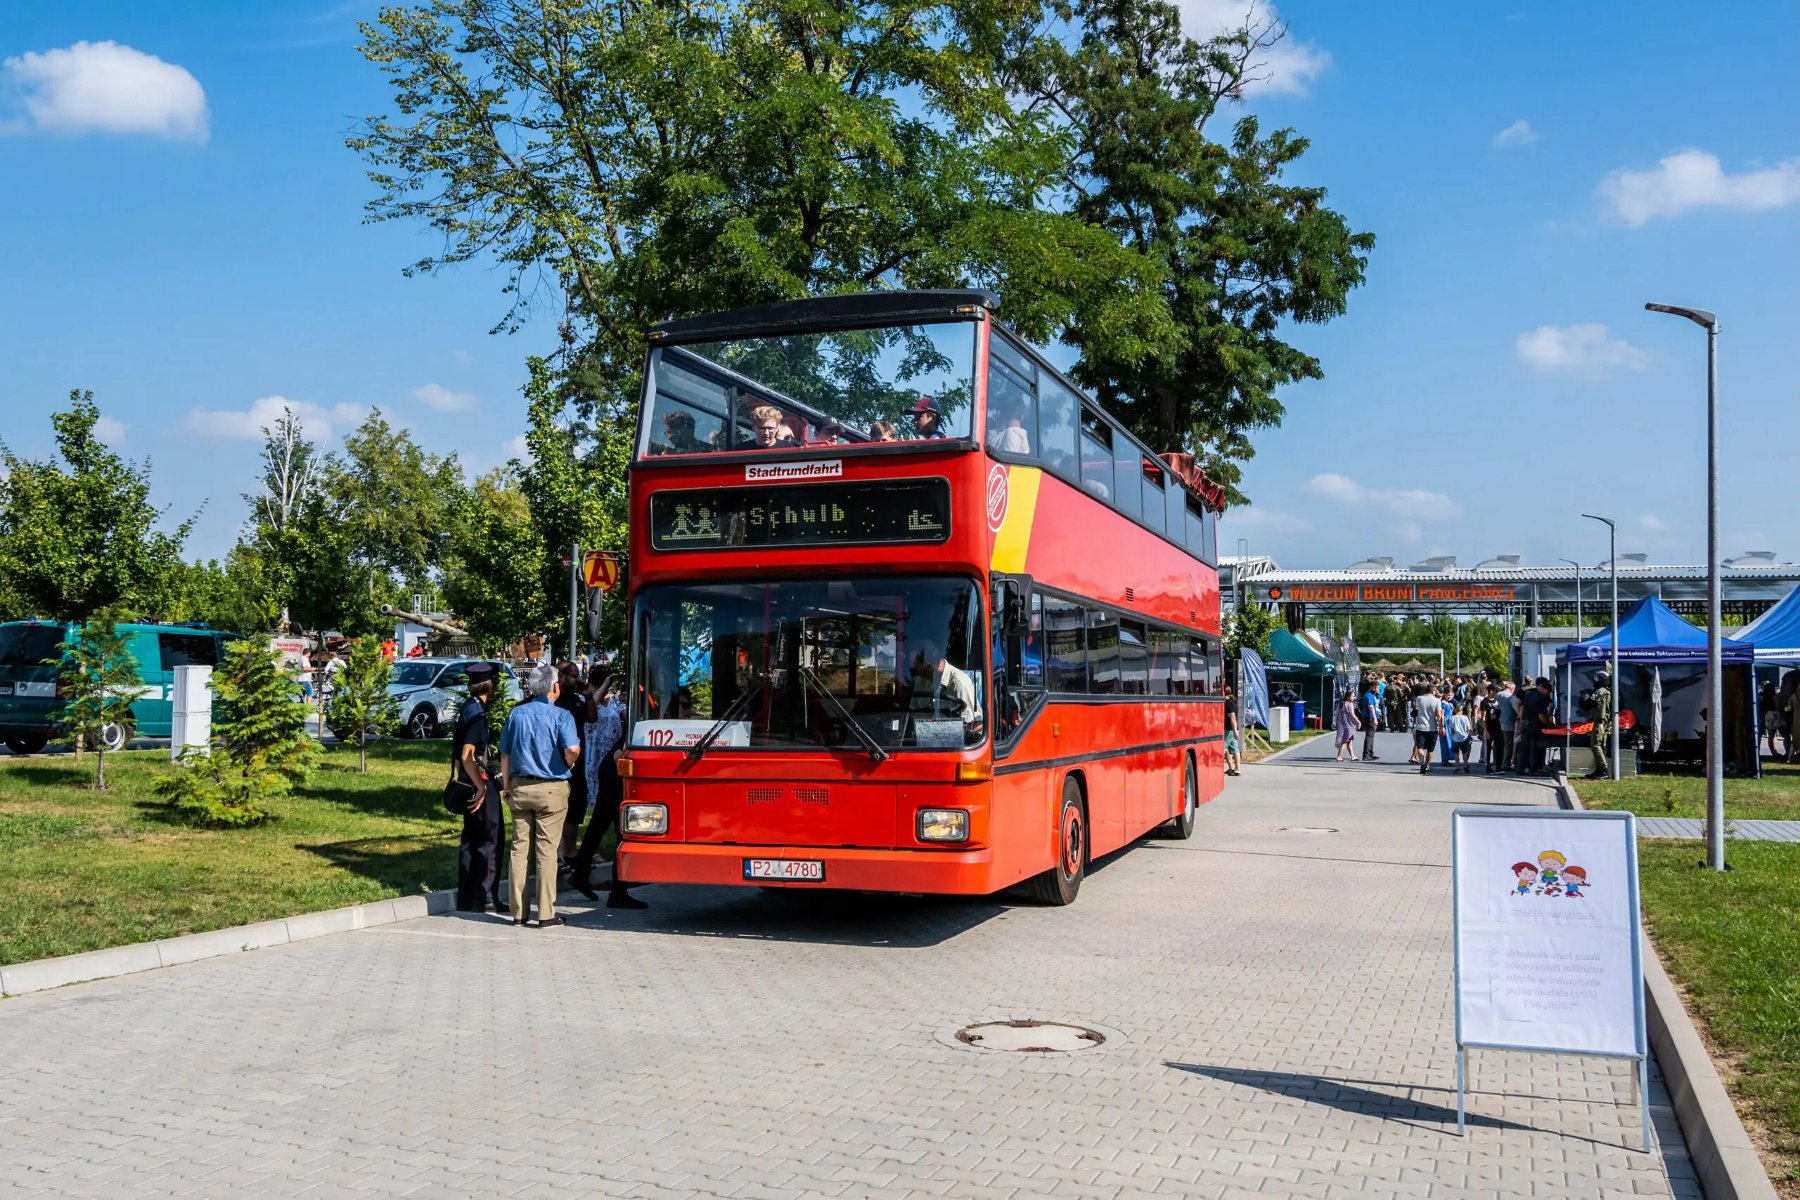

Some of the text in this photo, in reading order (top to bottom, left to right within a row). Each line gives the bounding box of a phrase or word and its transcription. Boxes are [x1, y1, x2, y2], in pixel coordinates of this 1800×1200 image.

[748, 463, 840, 478] Stadtrundfahrt
[589, 553, 612, 586] A
[1290, 583, 1515, 601] MUZEUM BRONI PANCERNEJ
[648, 729, 674, 746] 102
[785, 862, 818, 877] 4780
